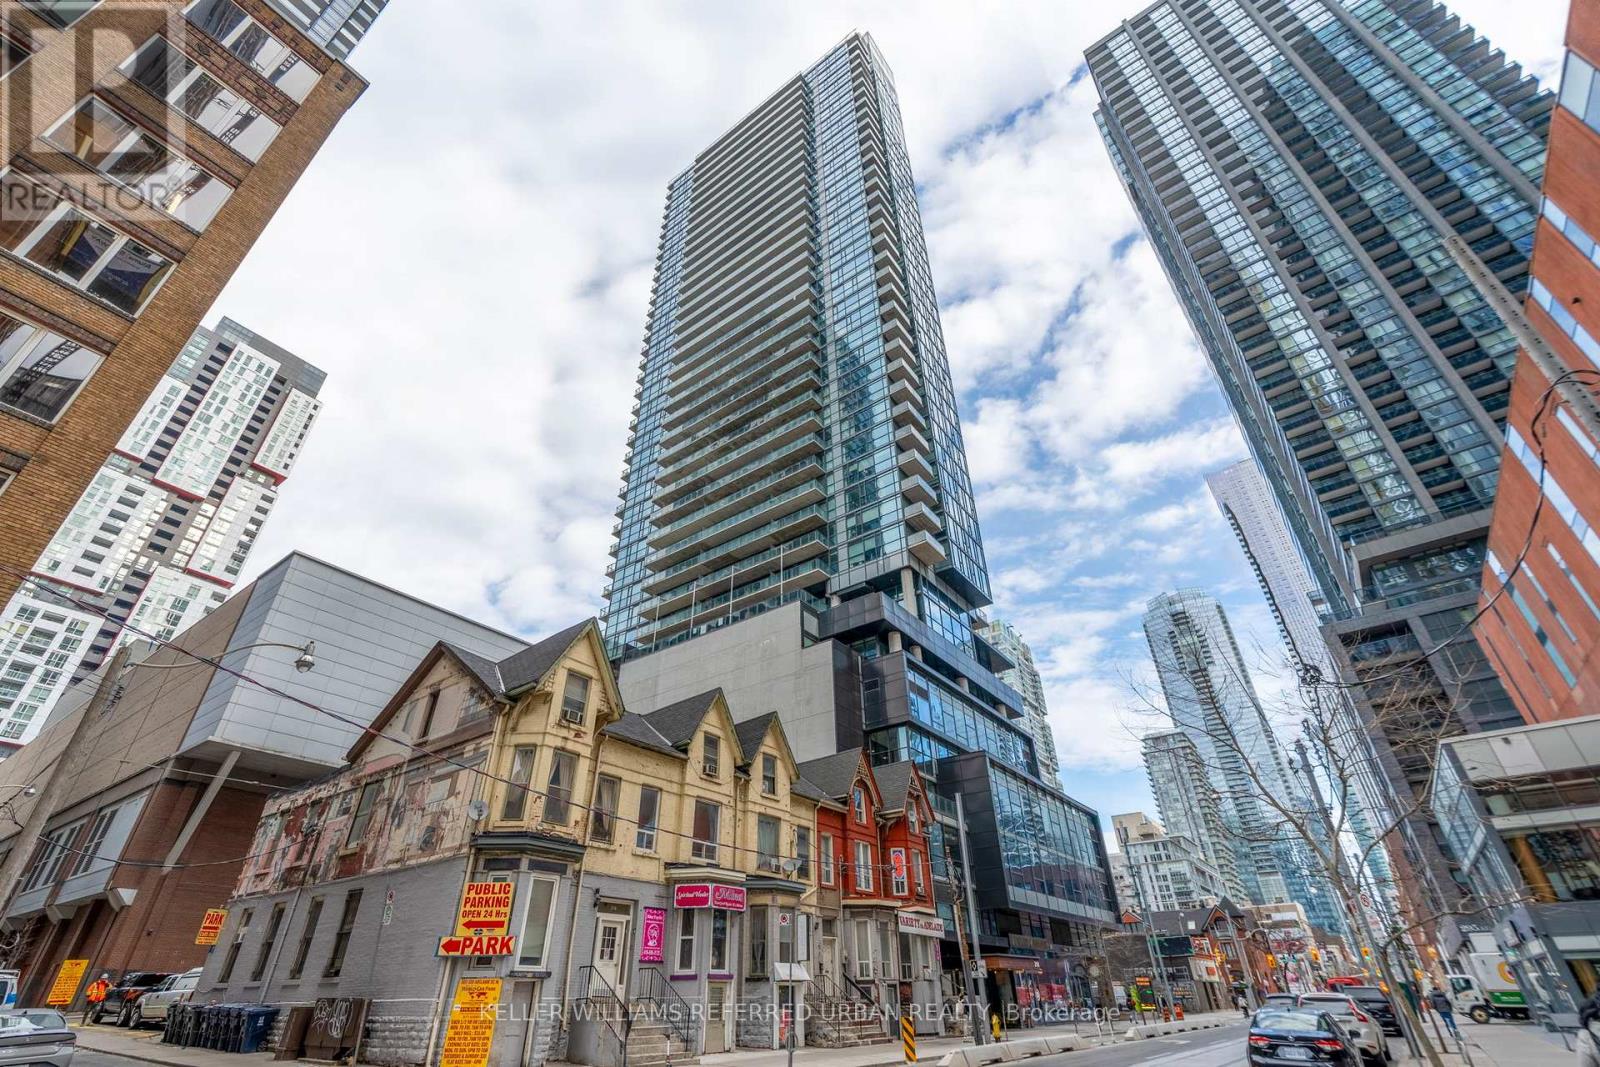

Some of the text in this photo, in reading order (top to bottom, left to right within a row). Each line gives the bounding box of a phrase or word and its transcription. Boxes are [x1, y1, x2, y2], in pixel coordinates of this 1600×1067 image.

[467, 883, 511, 895] PUBLIC
[463, 896, 509, 908] PARKING
[205, 913, 224, 925] PARK
[462, 909, 508, 918] OPEN 24 Hrs
[899, 917, 920, 929] VARIETY
[460, 936, 514, 955] PARK
